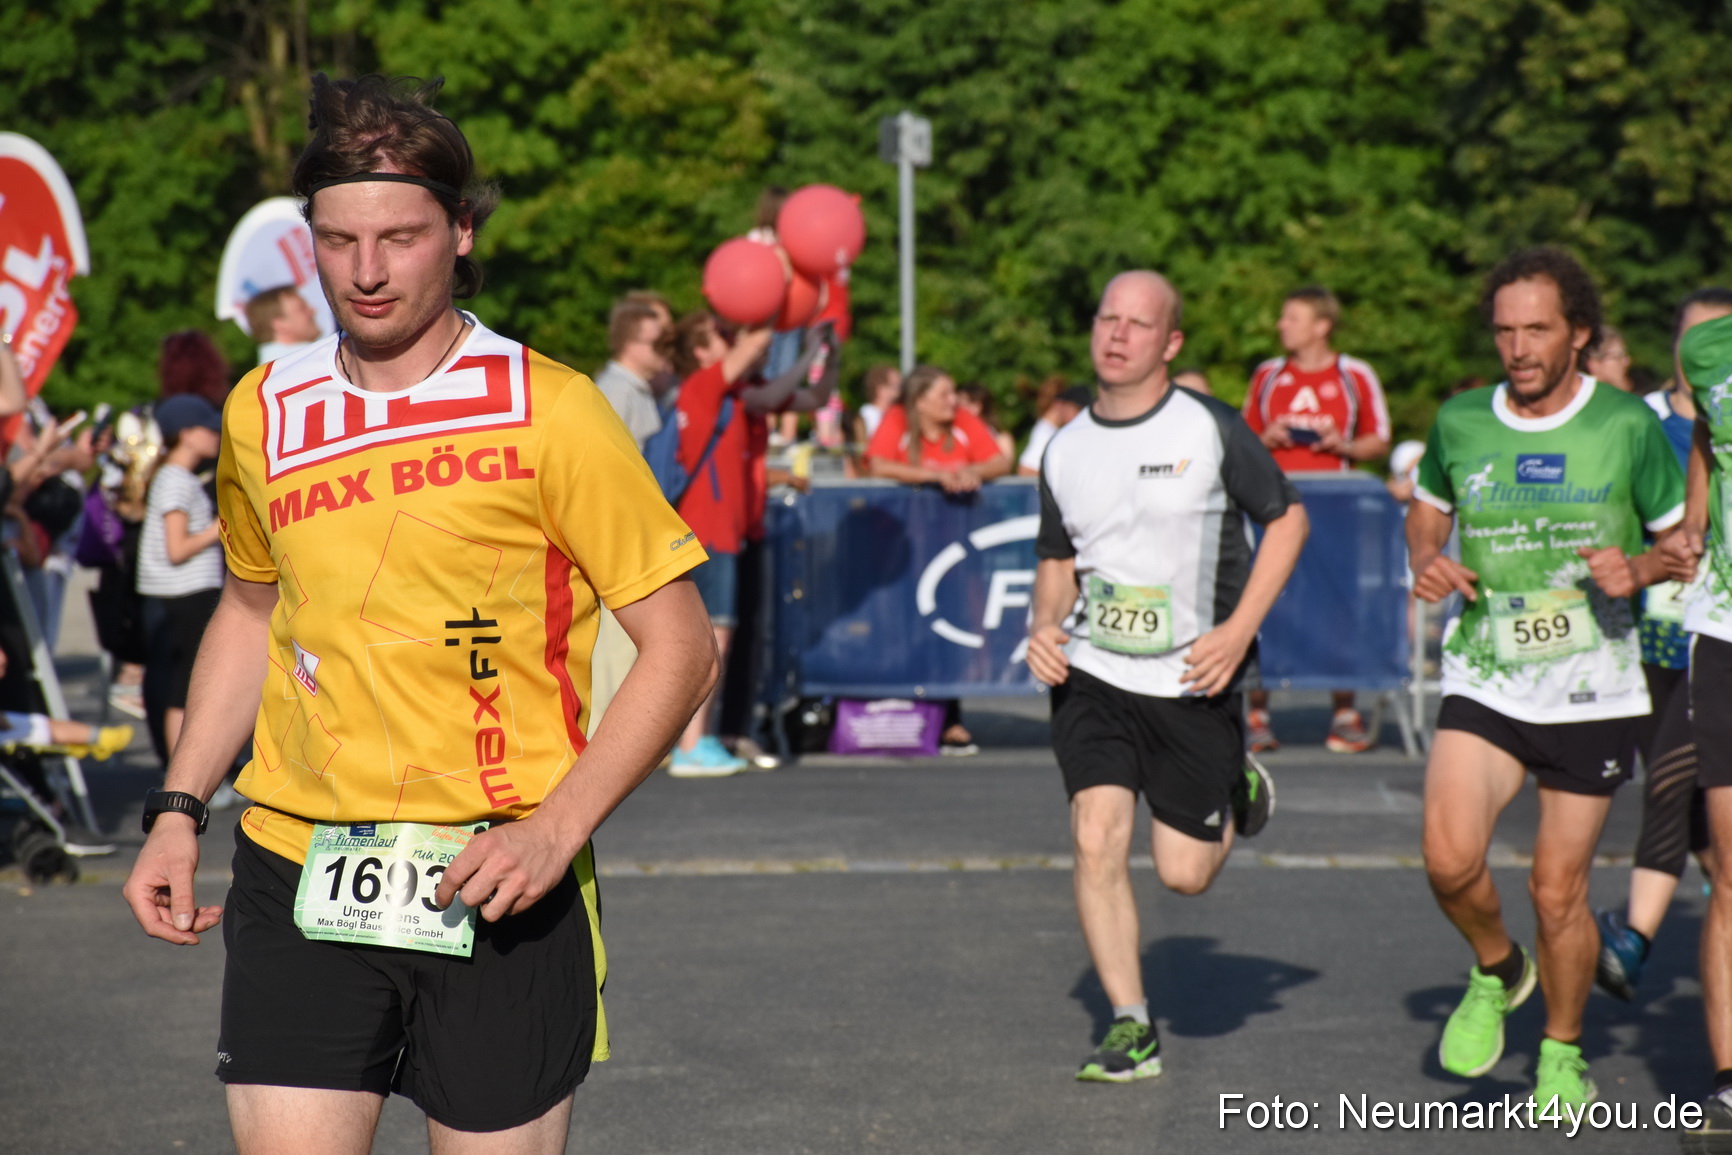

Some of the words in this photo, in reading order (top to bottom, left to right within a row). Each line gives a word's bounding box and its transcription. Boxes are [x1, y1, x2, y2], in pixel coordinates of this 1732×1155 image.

[269, 468, 375, 534] MAX
[391, 444, 535, 496] BÖGL
[1489, 481, 1613, 503] firmenlauf
[1097, 604, 1159, 634] 2279
[1514, 614, 1571, 645] 569
[335, 833, 398, 848] firmenlauf
[438, 852, 456, 864] 20
[325, 855, 448, 913] 1693
[343, 905, 384, 921] Unger
[316, 917, 335, 927] Max
[336, 919, 358, 931] Bögl
[414, 927, 444, 939] GmbH
